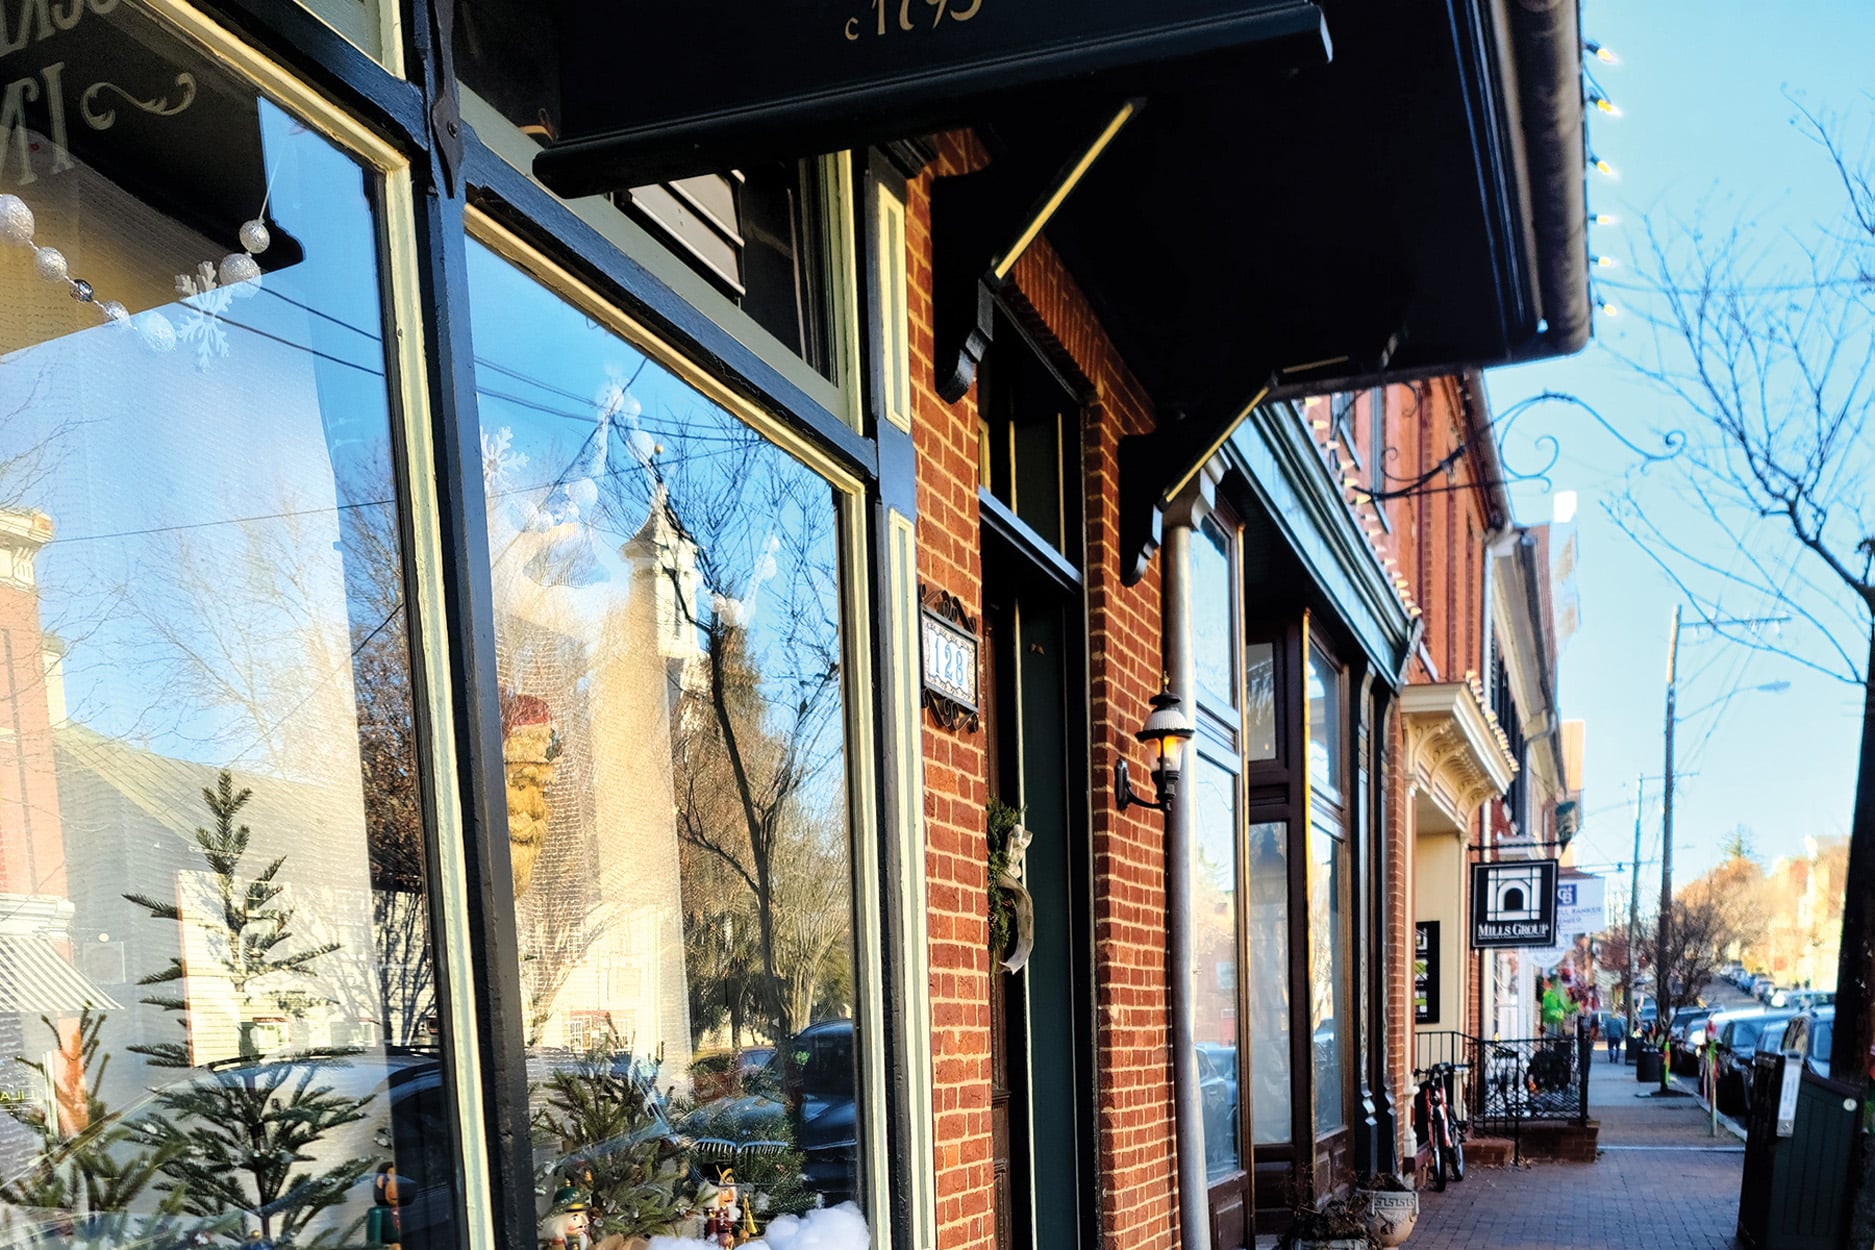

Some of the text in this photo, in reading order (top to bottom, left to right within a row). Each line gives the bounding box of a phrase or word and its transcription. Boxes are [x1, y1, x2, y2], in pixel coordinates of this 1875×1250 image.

[935, 638, 963, 686] 128
[1478, 922, 1549, 936] MILLS GROUP
